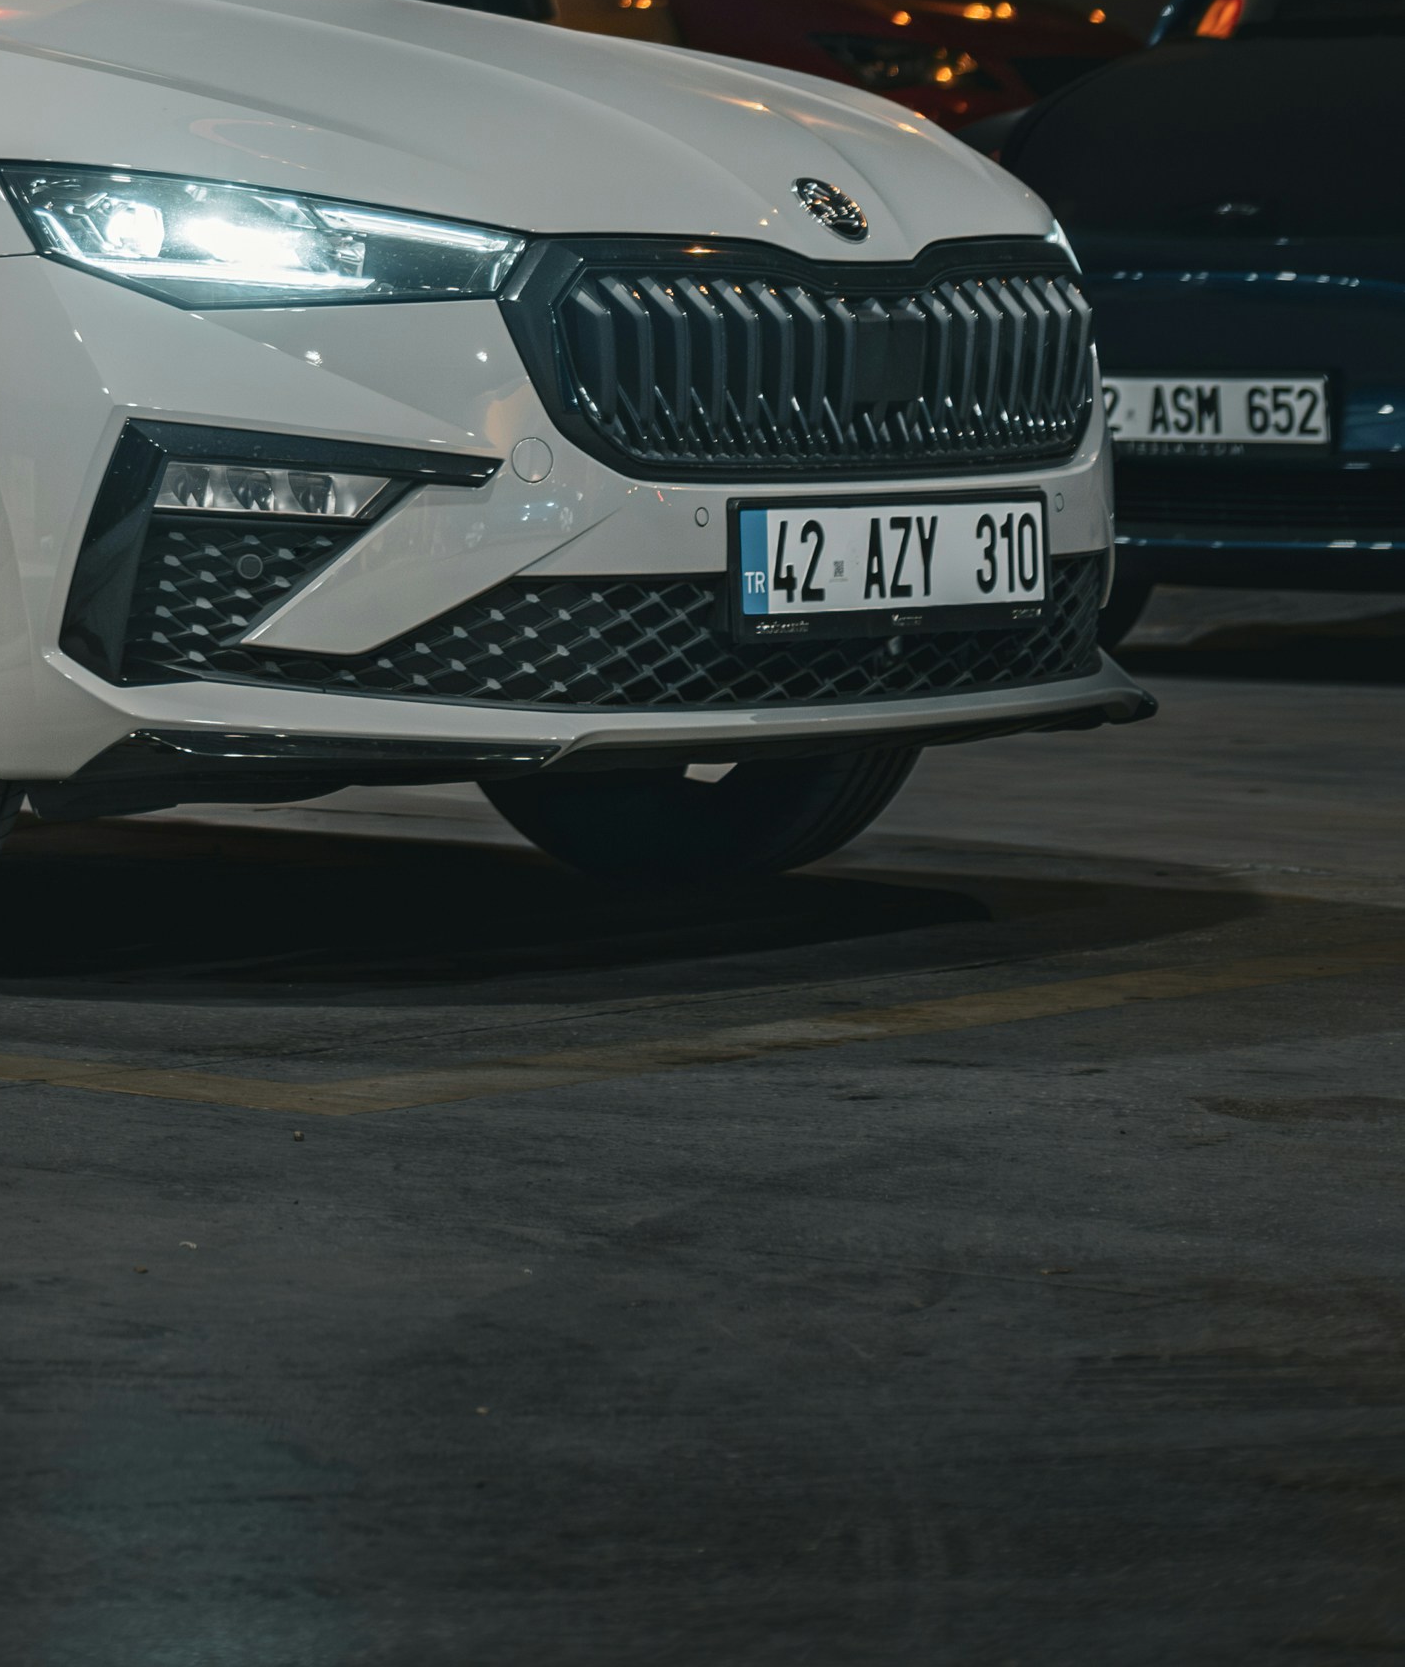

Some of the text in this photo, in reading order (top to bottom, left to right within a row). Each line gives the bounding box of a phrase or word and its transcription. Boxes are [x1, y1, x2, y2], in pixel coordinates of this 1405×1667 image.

[1149, 385, 1222, 435] ASM
[1246, 386, 1322, 435] 652
[744, 512, 1039, 603] TR 42 AZY 310
